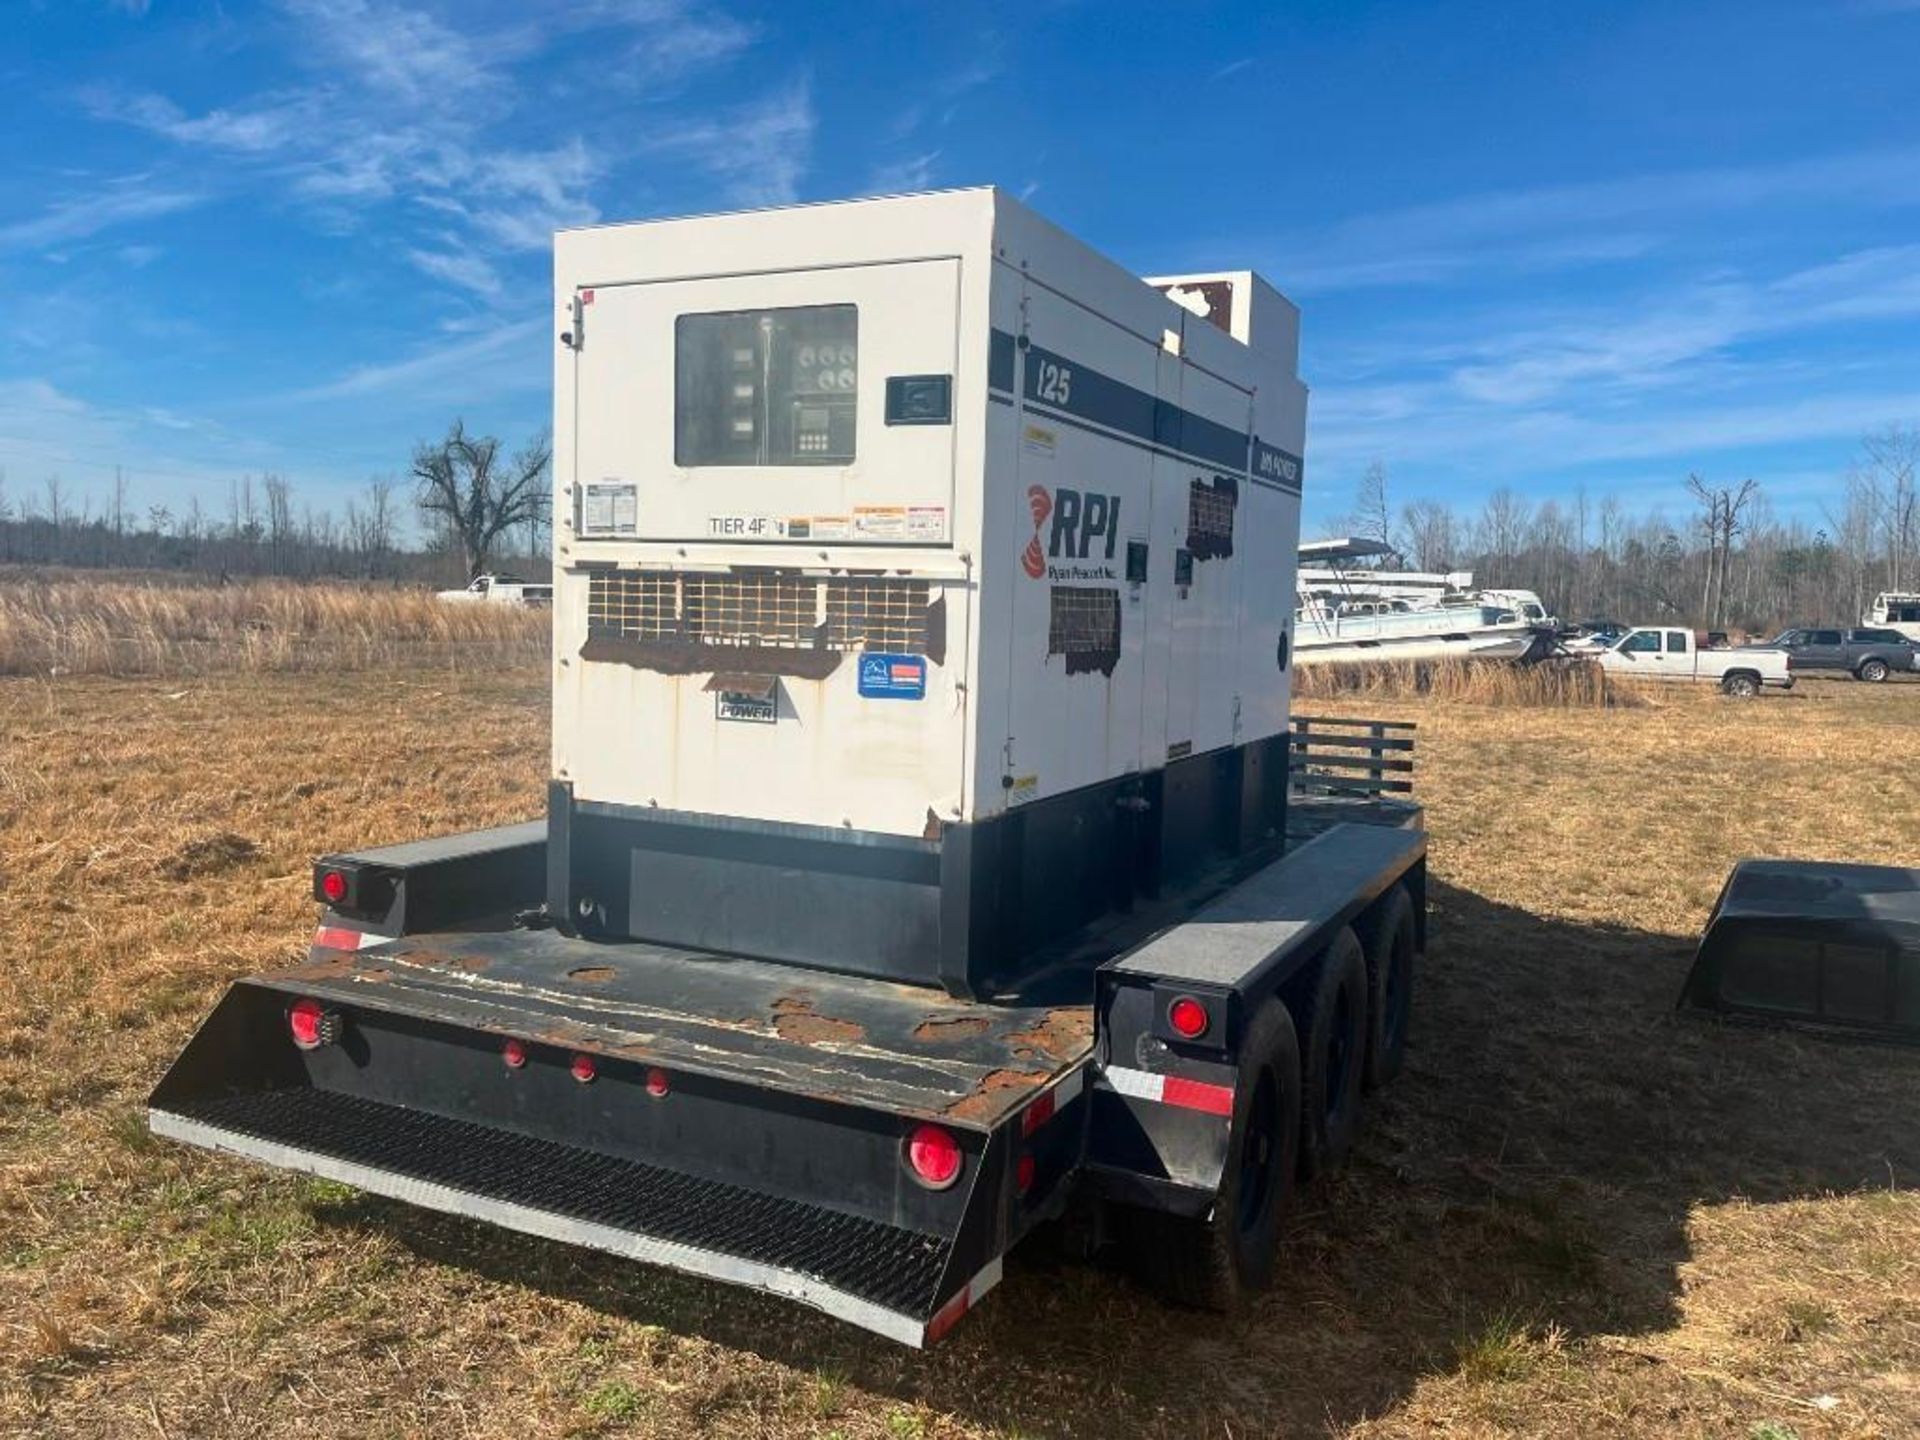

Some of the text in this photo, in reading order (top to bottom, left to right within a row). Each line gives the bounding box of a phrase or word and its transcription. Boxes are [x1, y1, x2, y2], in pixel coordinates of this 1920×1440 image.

[1037, 359, 1072, 405] 125
[710, 517, 767, 534] TIER 4F
[1048, 488, 1121, 559] RPI
[721, 704, 773, 719] POWER
